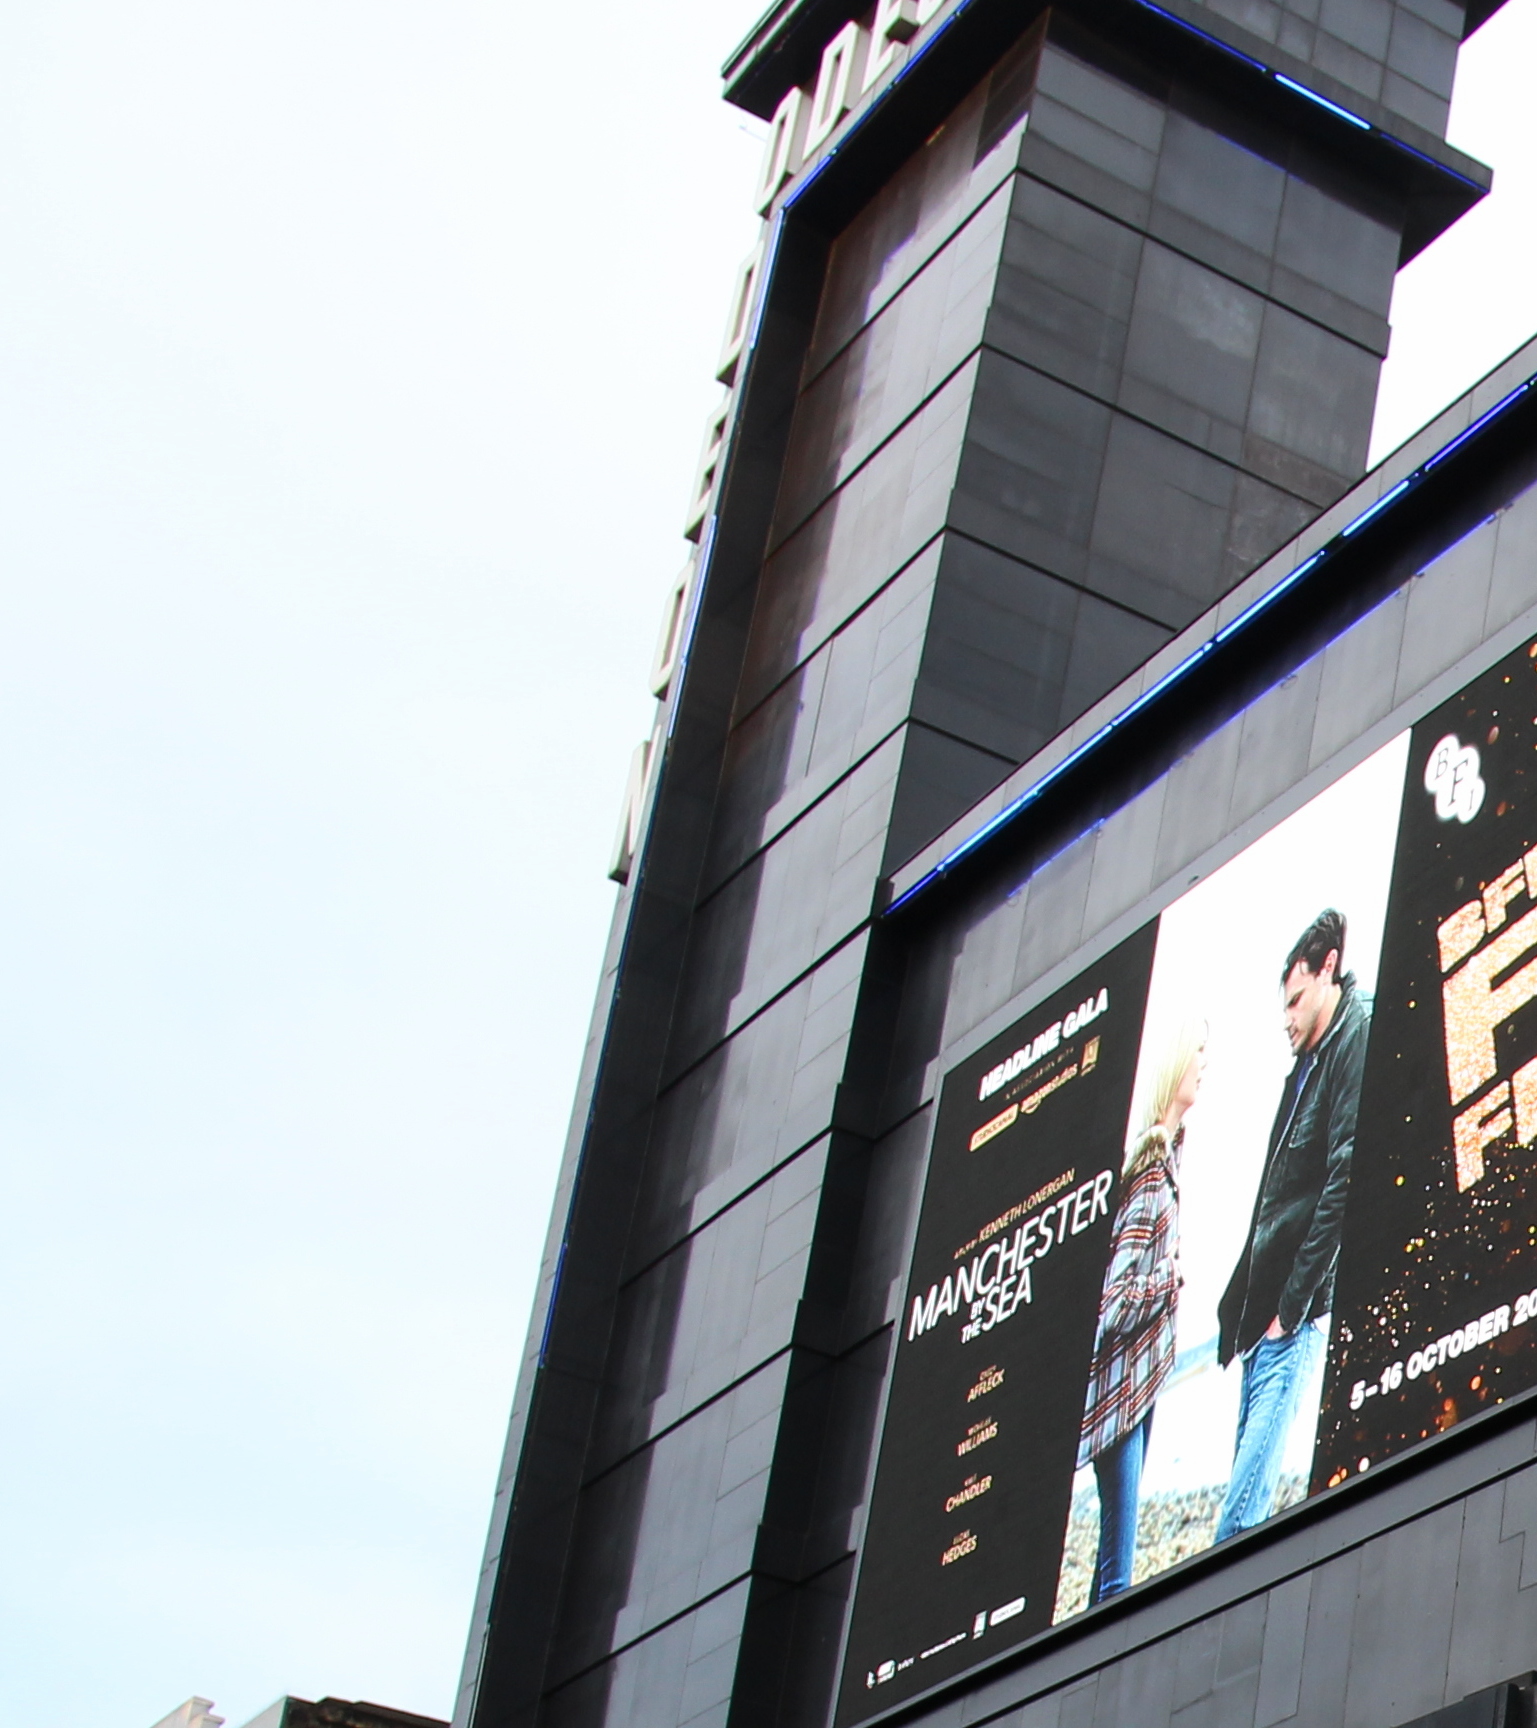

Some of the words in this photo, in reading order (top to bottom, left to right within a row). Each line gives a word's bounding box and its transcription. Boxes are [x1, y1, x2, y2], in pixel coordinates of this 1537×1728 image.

[978, 1020, 1063, 1102] HEADLINE
[1062, 986, 1110, 1040] GALA
[978, 1205, 1022, 1244] KENNETH
[1021, 1167, 1076, 1215] LONERGAN
[907, 1167, 1115, 1343] MANCHESTER
[969, 1296, 986, 1320] BY
[980, 1265, 1034, 1333] SEA
[960, 1316, 983, 1345] THE
[1405, 1303, 1511, 1381] OCTOBER
[966, 1368, 1005, 1403] AFFLECK
[956, 1421, 999, 1457] WILLIAMS
[944, 1474, 993, 1513] CHANDLER
[941, 1534, 978, 1567] HEDGES
